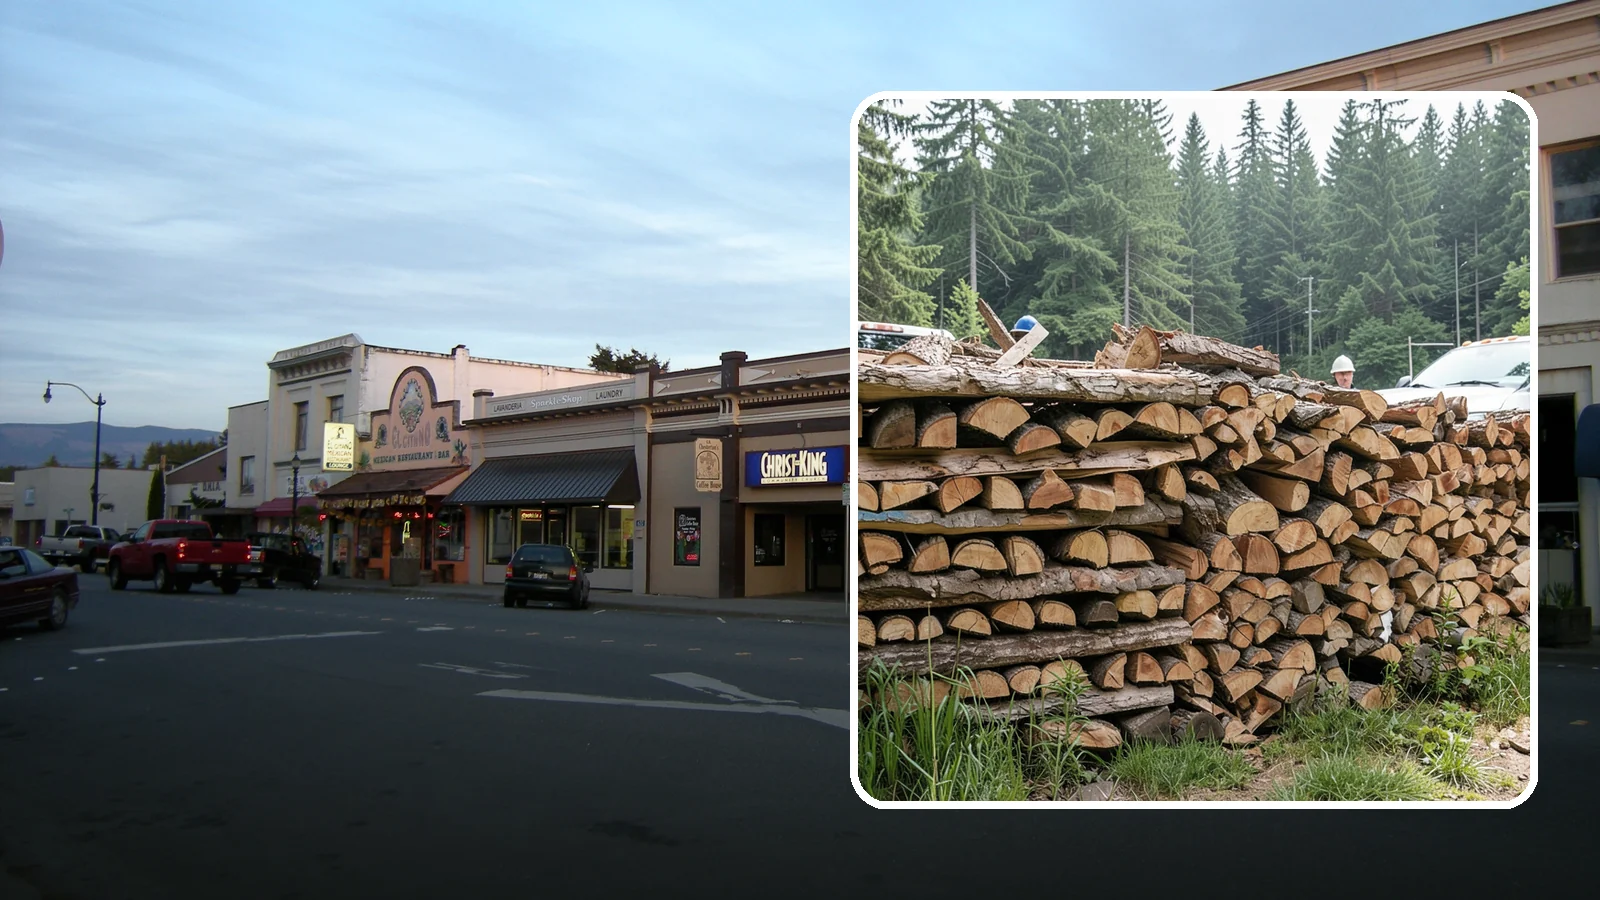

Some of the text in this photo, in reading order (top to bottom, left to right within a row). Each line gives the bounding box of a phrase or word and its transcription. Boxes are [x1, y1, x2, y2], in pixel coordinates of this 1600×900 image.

[493, 401, 522, 413] LAVANDERIA
[561, 394, 582, 406] Shop
[595, 388, 623, 400] LAUNDRY
[373, 454, 396, 464] MEXICAN
[397, 451, 433, 463] RESTAURANT
[438, 450, 450, 459] BAR
[761, 450, 827, 478] CHRIST KING
